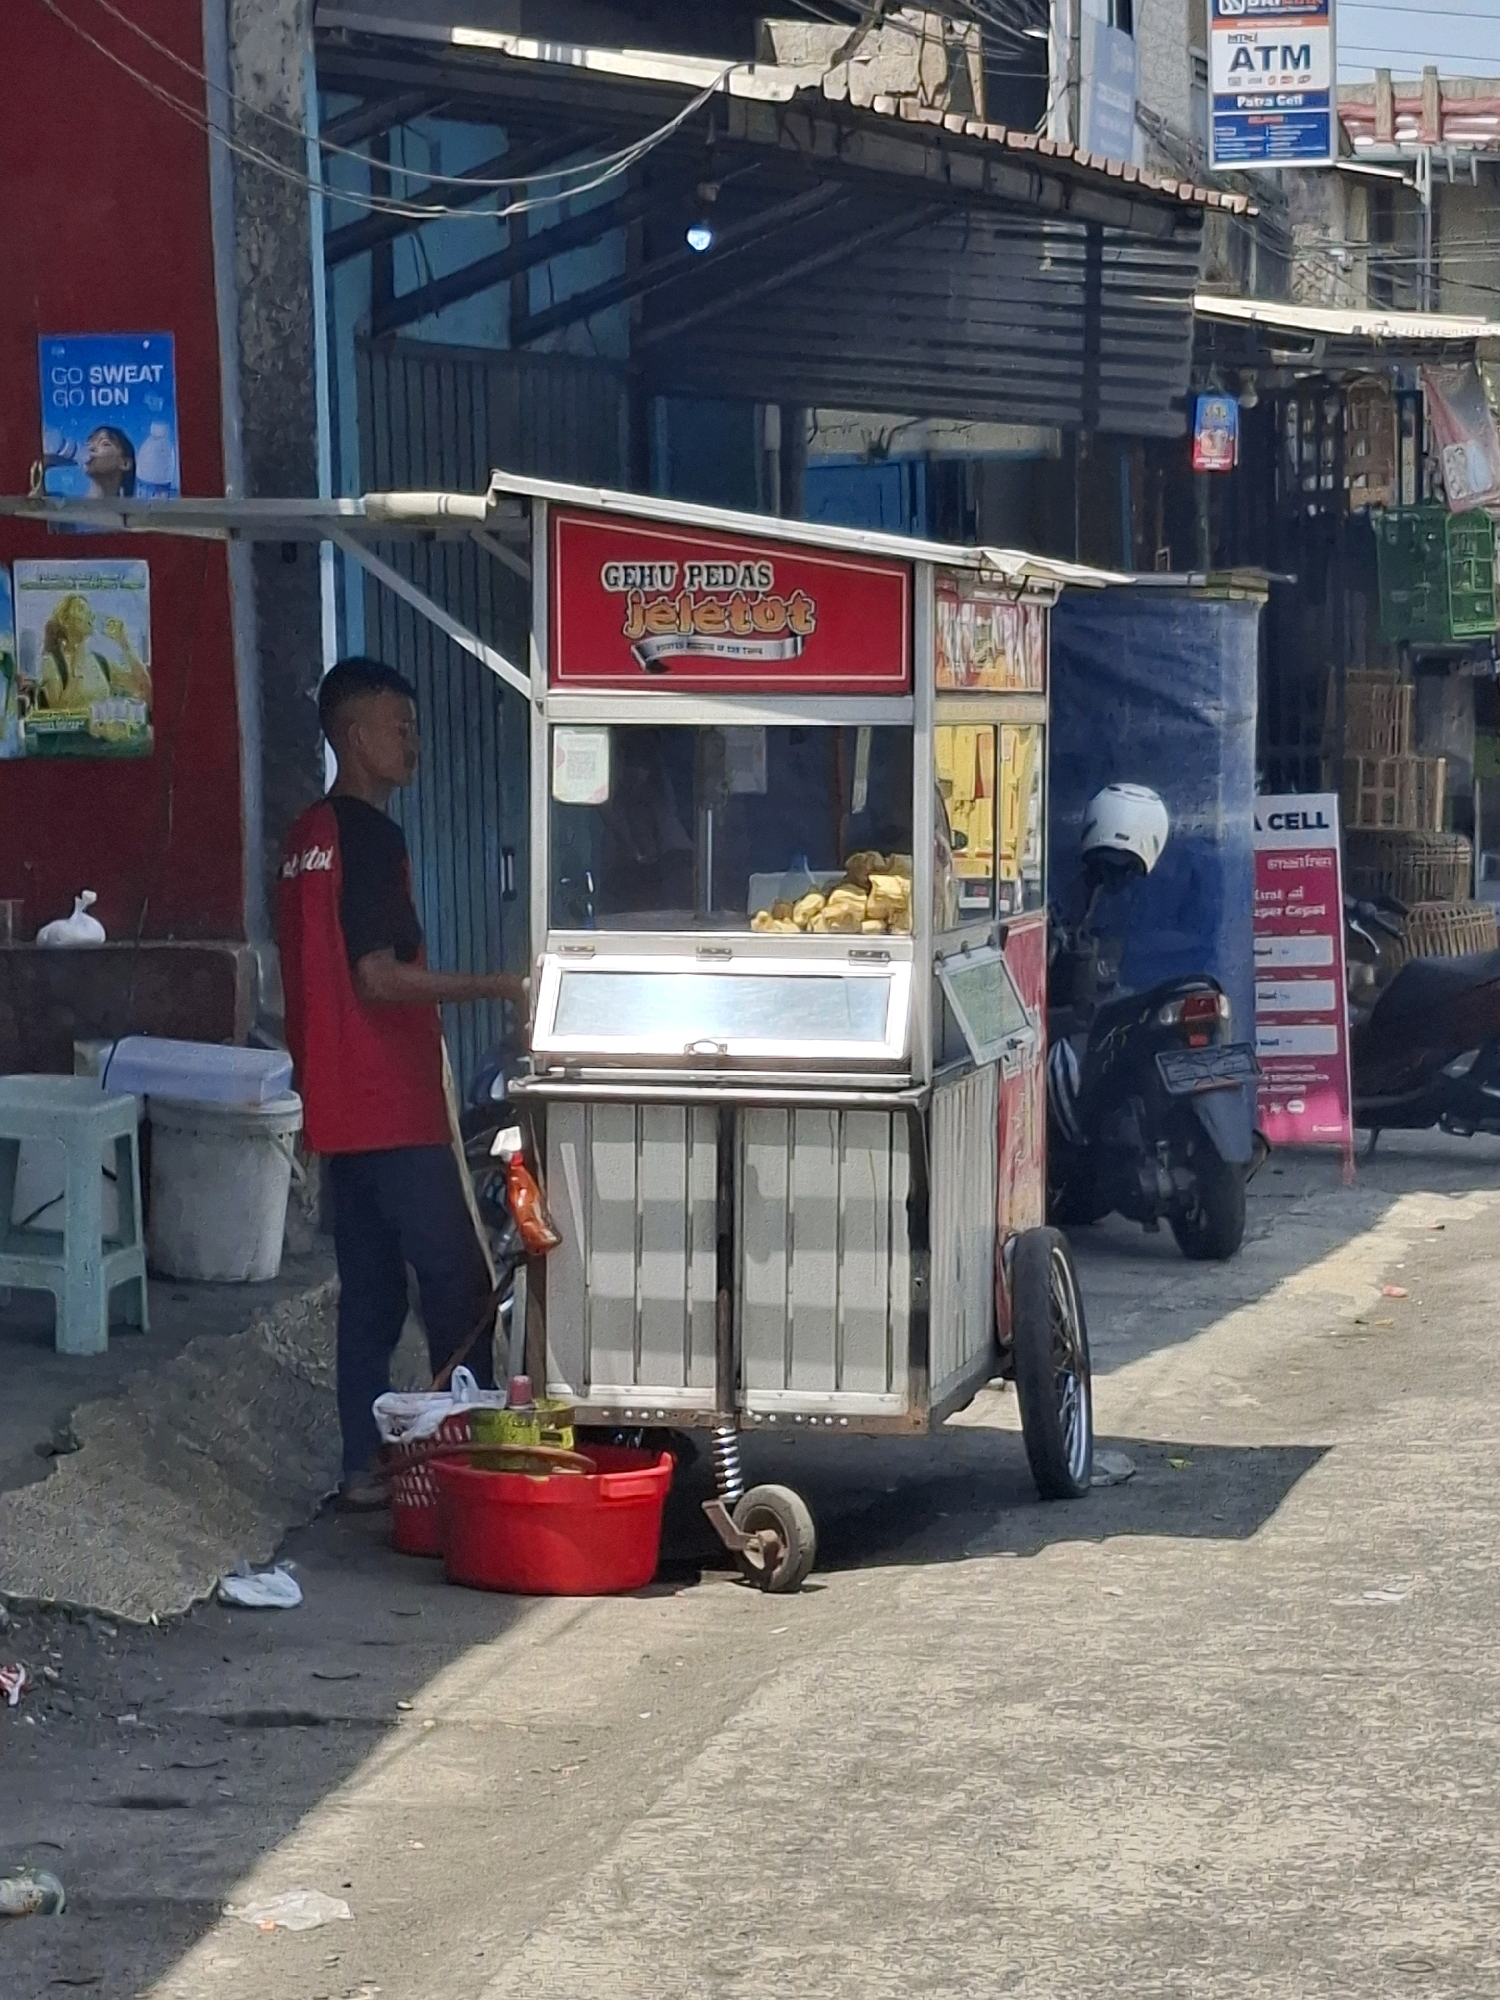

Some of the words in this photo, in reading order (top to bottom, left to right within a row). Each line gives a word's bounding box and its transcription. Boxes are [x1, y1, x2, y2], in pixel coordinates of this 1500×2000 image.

[1228, 44, 1311, 73] ATM
[51, 366, 83, 385] GO
[89, 364, 164, 385] SWEAT
[53, 389, 85, 408] GO
[90, 387, 129, 407] ION
[603, 562, 676, 589] GEHU
[686, 562, 772, 589] PEDAS
[624, 588, 817, 638] jeletot
[1267, 811, 1330, 831] CELL
